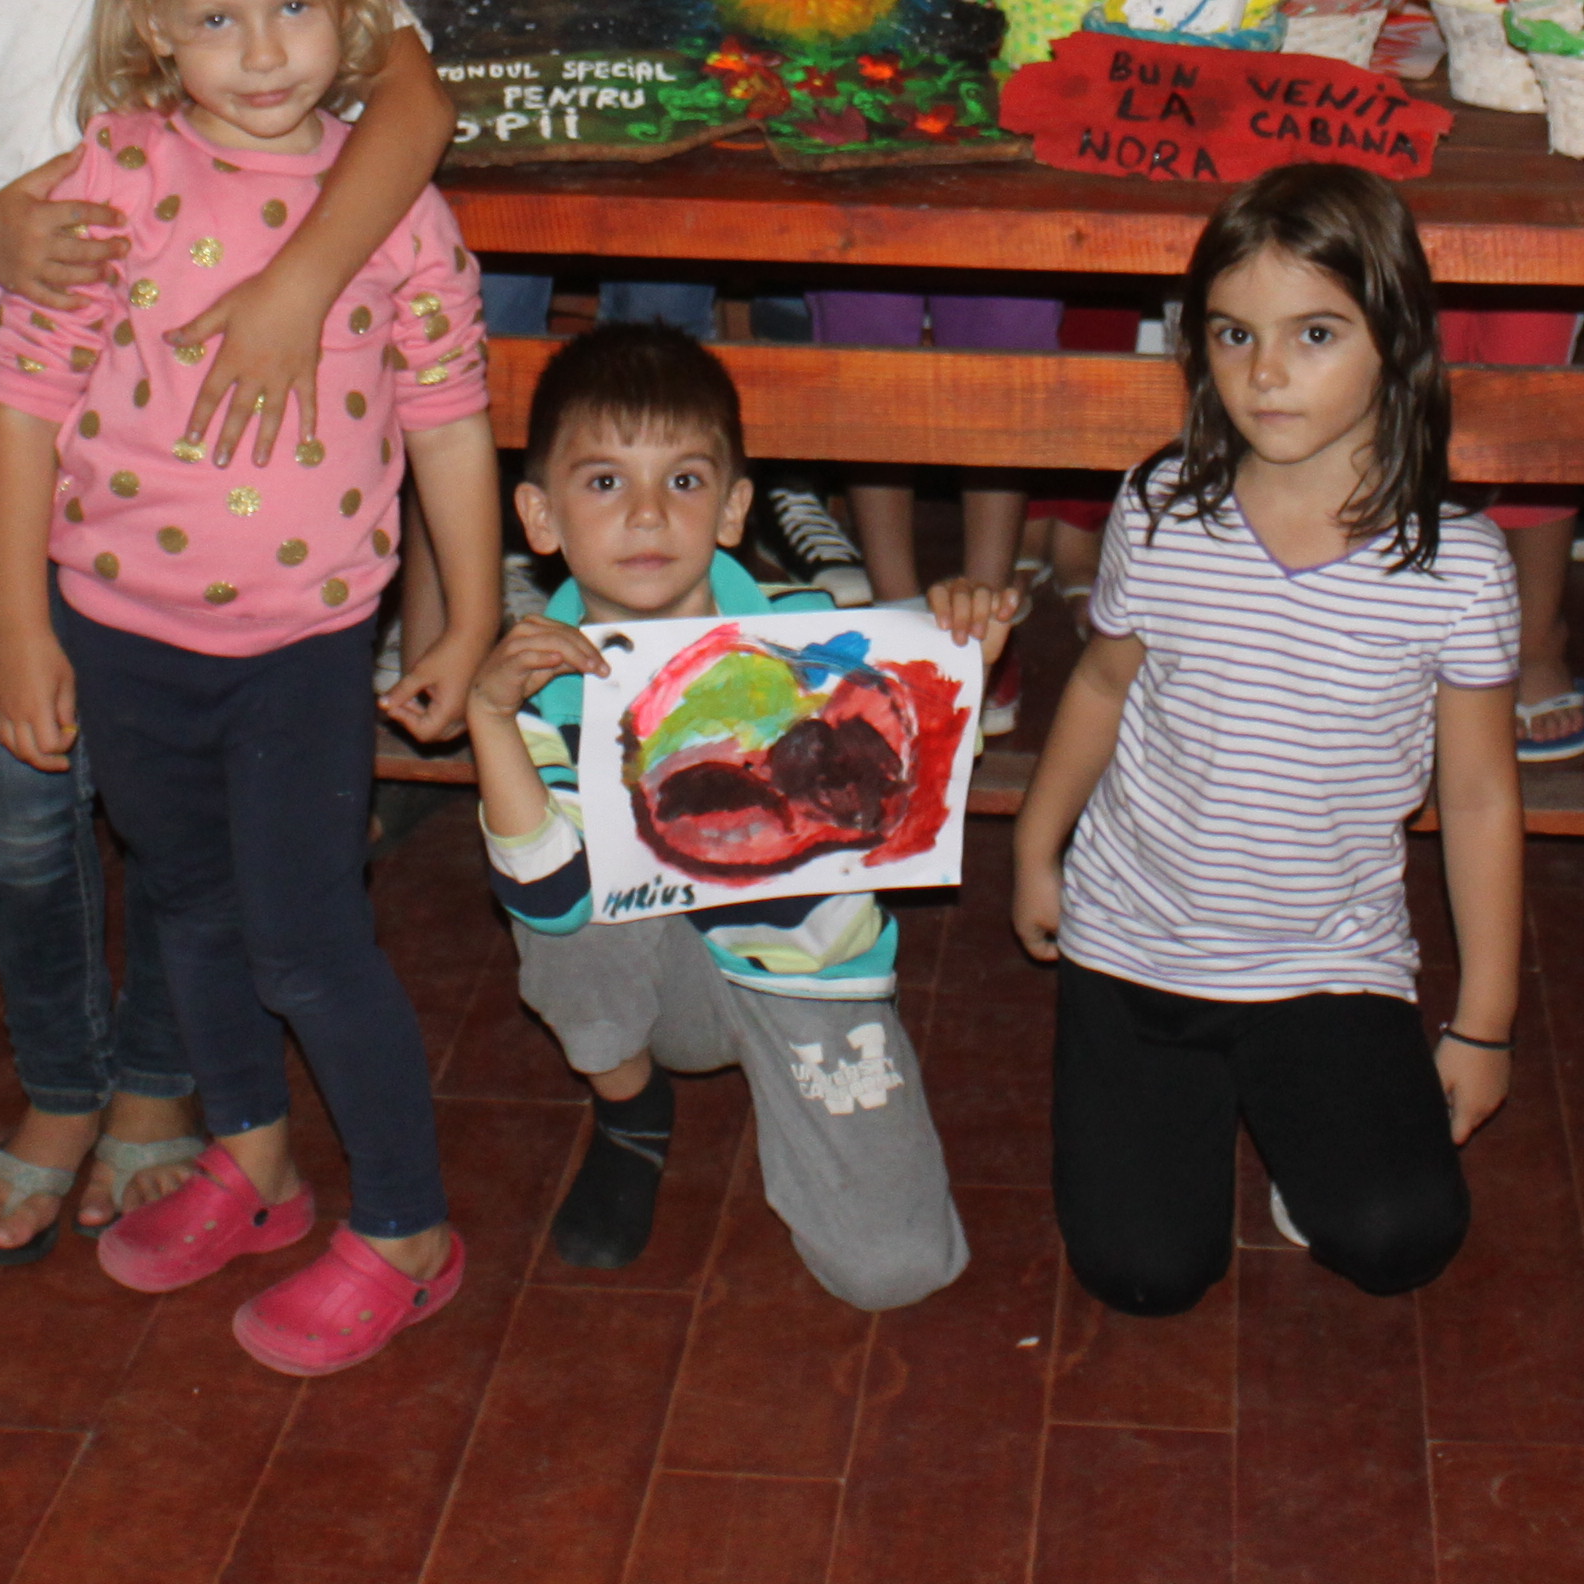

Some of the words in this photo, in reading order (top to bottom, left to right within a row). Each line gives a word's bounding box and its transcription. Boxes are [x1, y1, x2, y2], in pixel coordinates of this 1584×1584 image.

[1109, 50, 1199, 89] BUN
[503, 85, 646, 110] PENTRU
[1117, 87, 1195, 127] LA
[1250, 111, 1420, 164] CABANA
[1079, 128, 1219, 179] NORA
